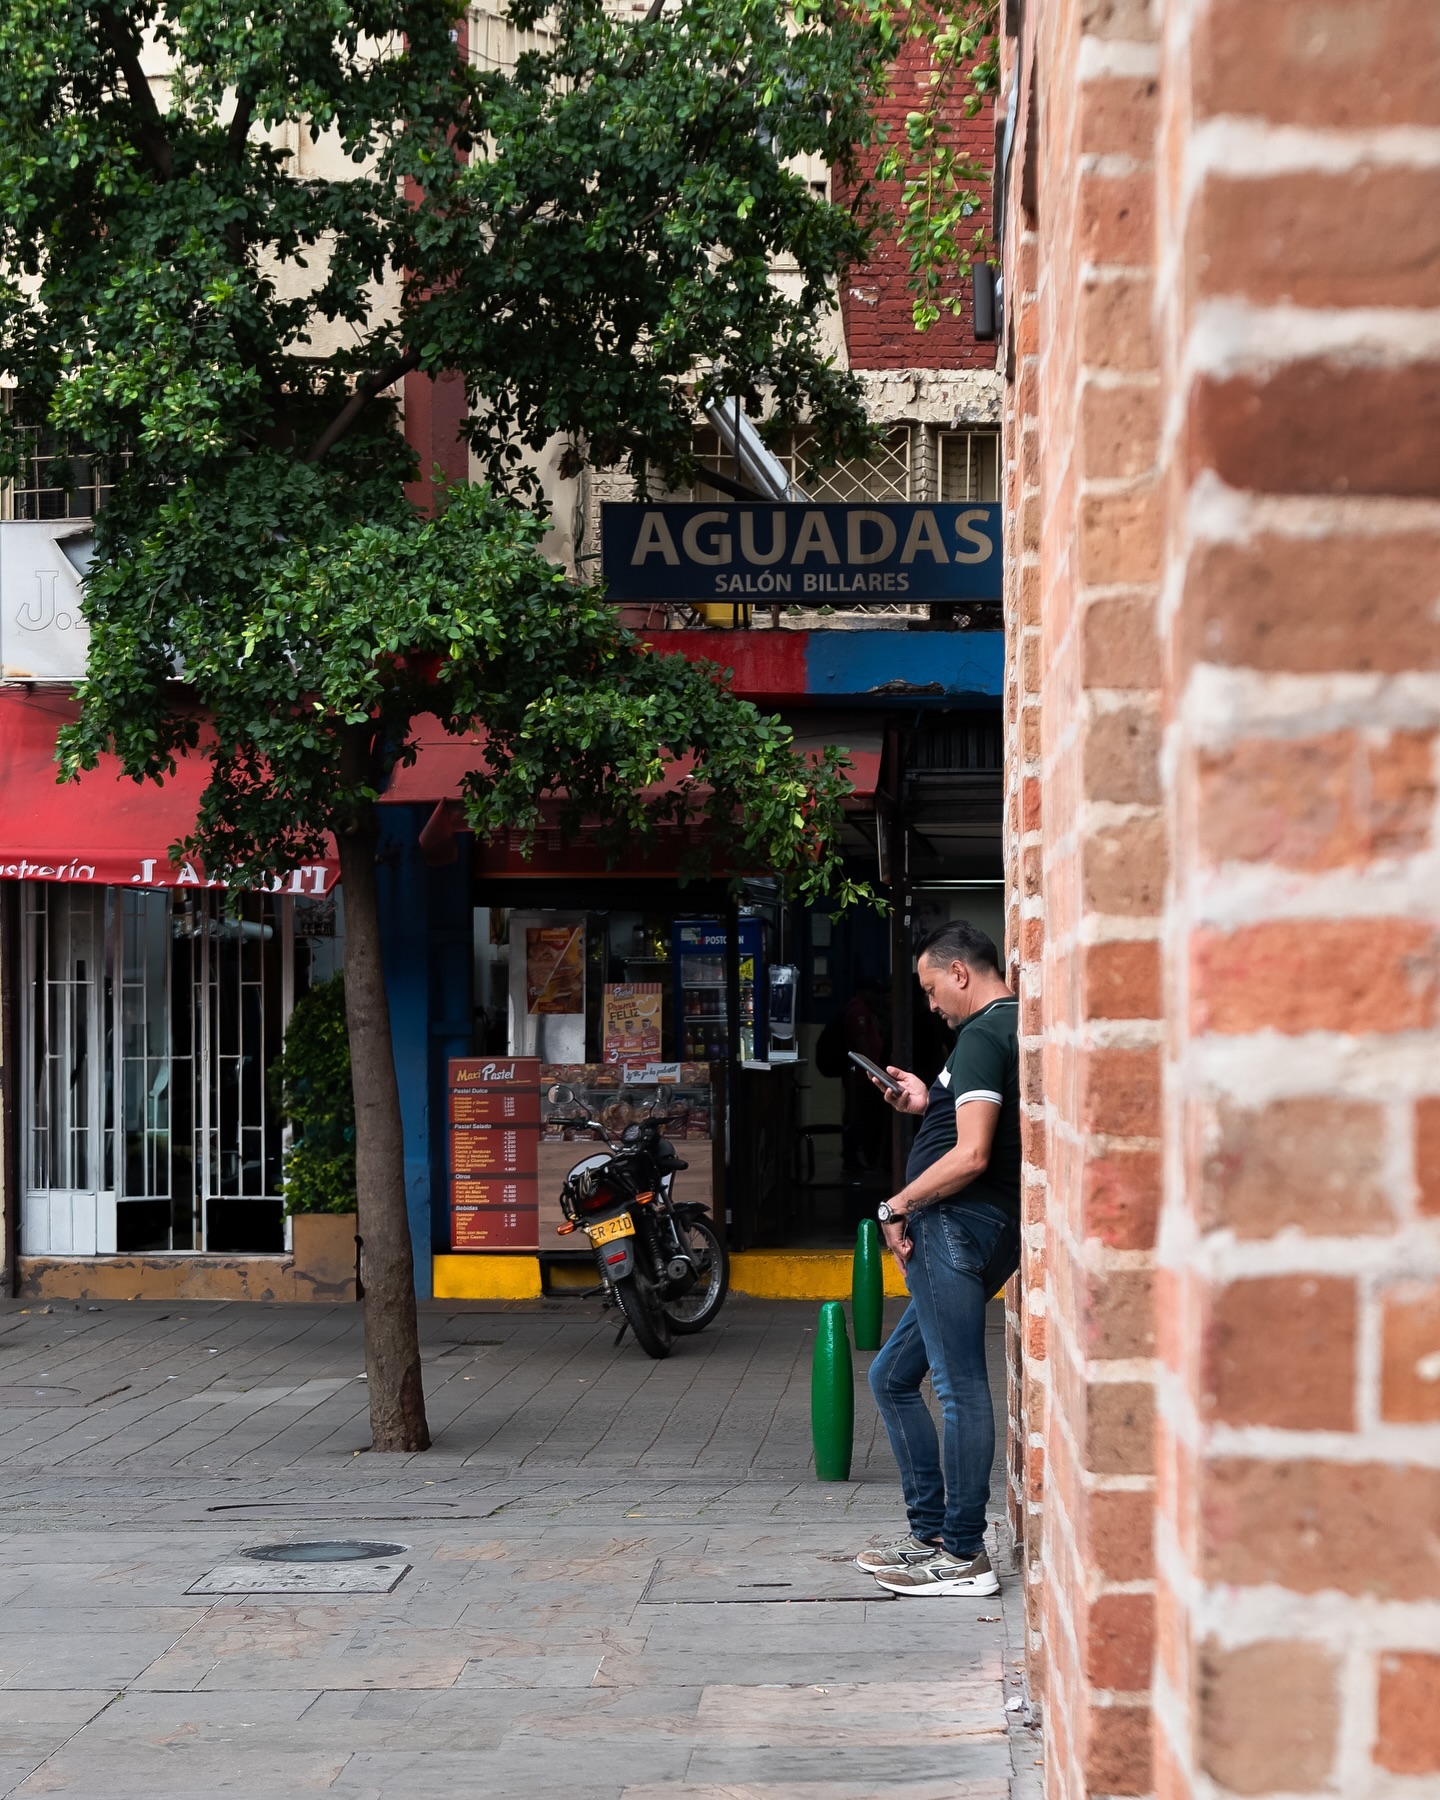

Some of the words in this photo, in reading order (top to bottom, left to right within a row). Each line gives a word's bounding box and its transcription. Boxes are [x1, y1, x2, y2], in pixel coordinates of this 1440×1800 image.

[630, 509, 993, 566] AGUADAS
[714, 570, 792, 593] SALÓN
[803, 572, 910, 592] BILLARES
[610, 1008, 640, 1020] FELIZ
[609, 1048, 619, 1062] 3
[456, 1069, 481, 1082] Maxi
[482, 1062, 515, 1081] Pastel
